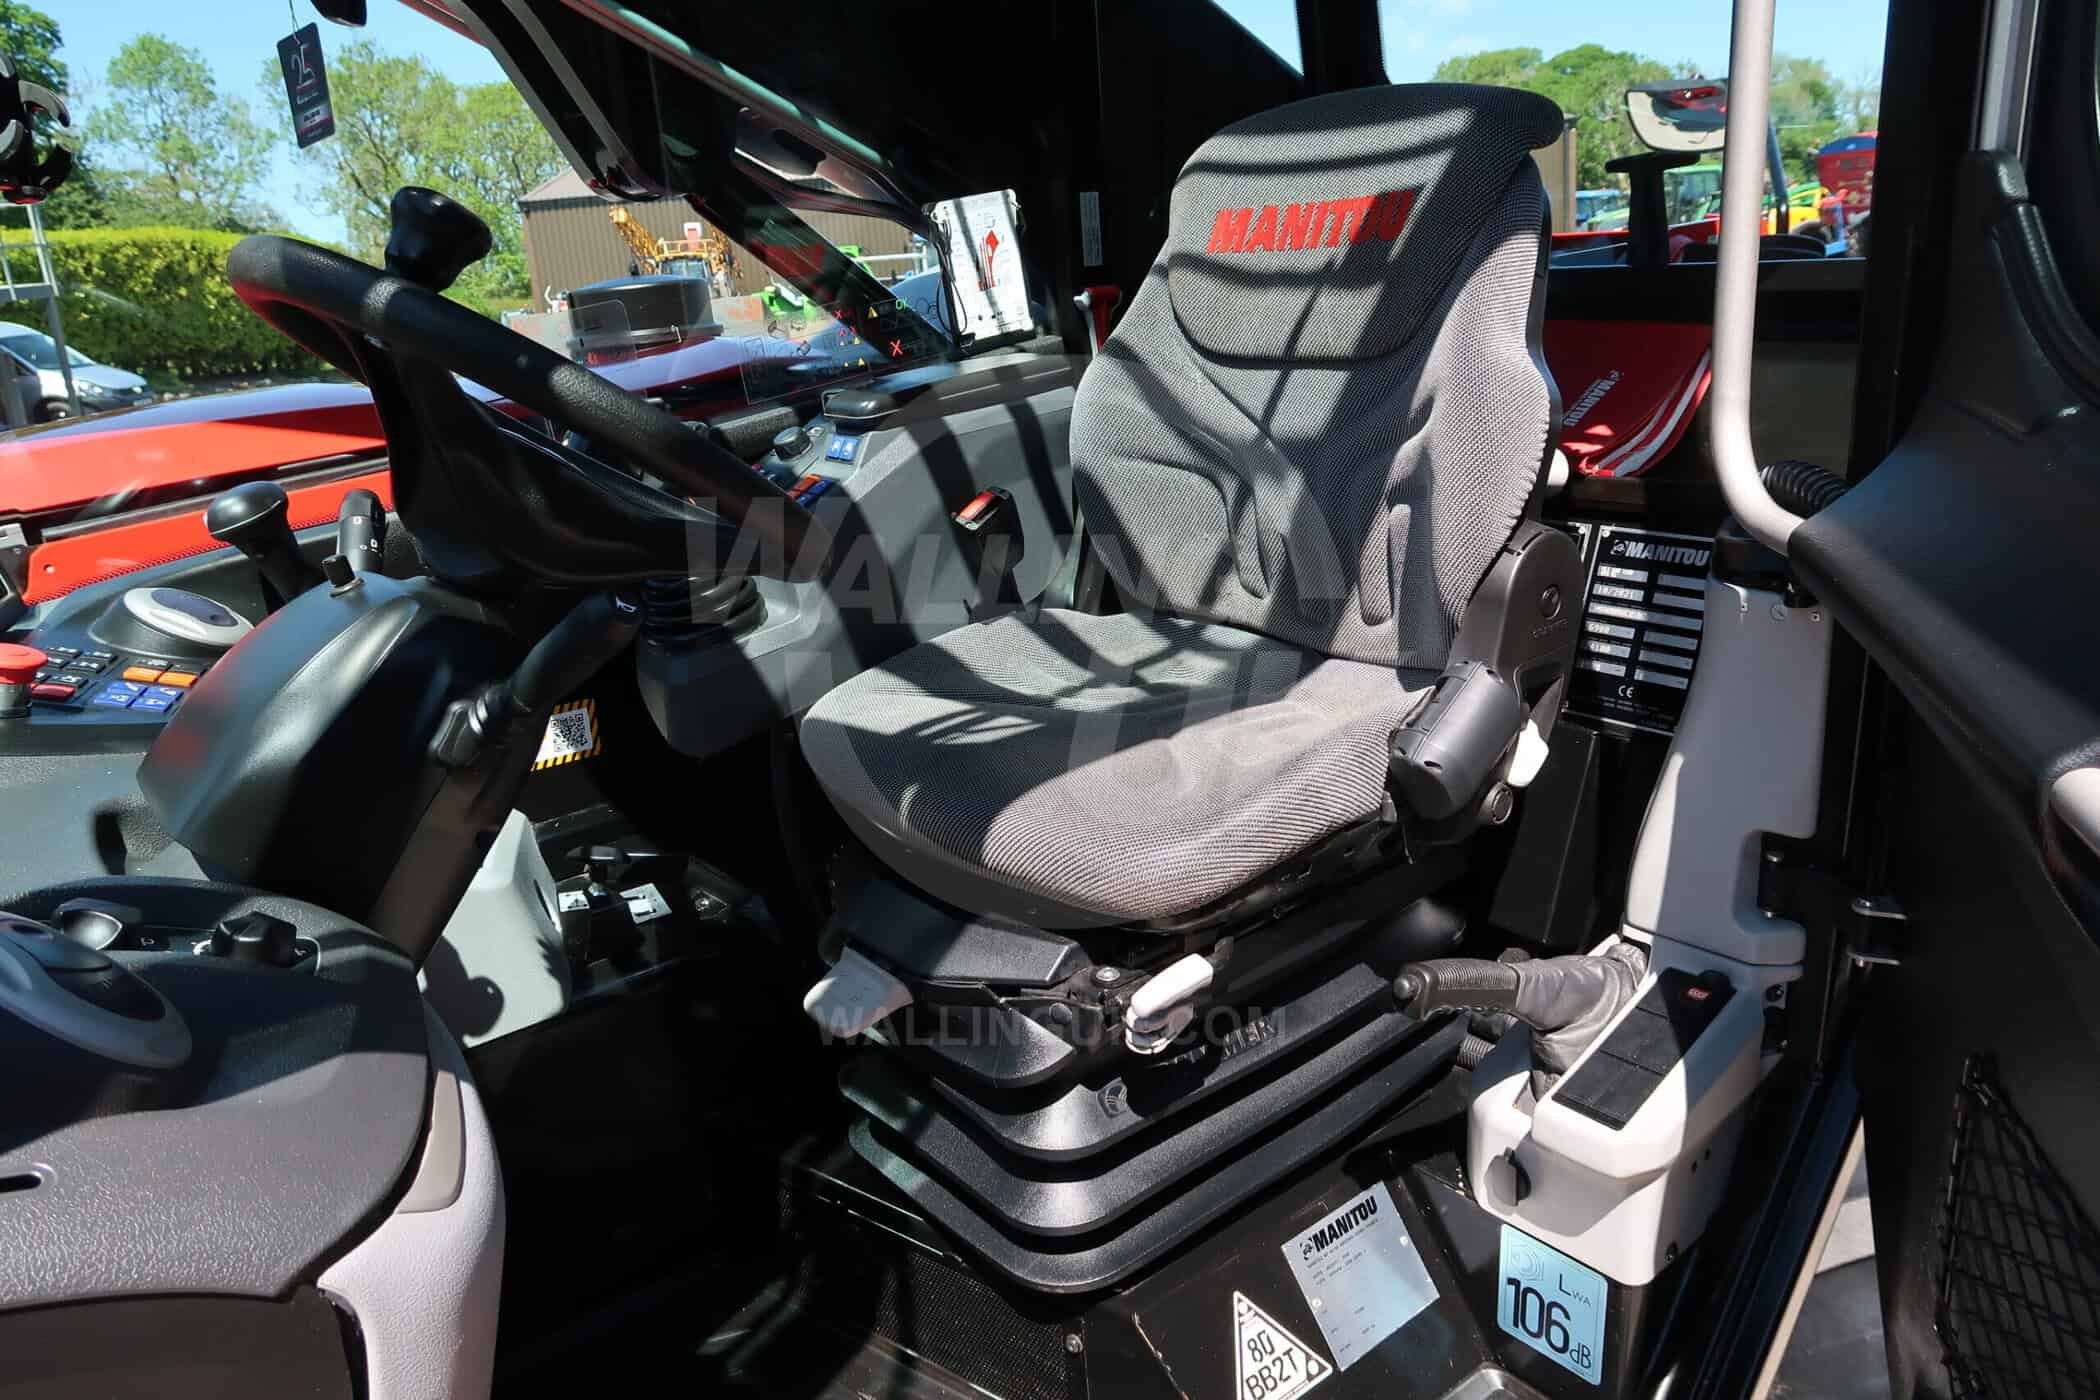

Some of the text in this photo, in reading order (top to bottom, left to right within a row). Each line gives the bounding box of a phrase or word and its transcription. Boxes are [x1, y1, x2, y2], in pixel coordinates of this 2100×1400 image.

[1206, 188, 1418, 253] MANITOU
[1624, 540, 1711, 567] MANITOU
[1312, 1196, 1379, 1252] MANITOU
[1506, 1277, 1592, 1369] 106 dB
[1245, 1348, 1297, 1400] BB2T
